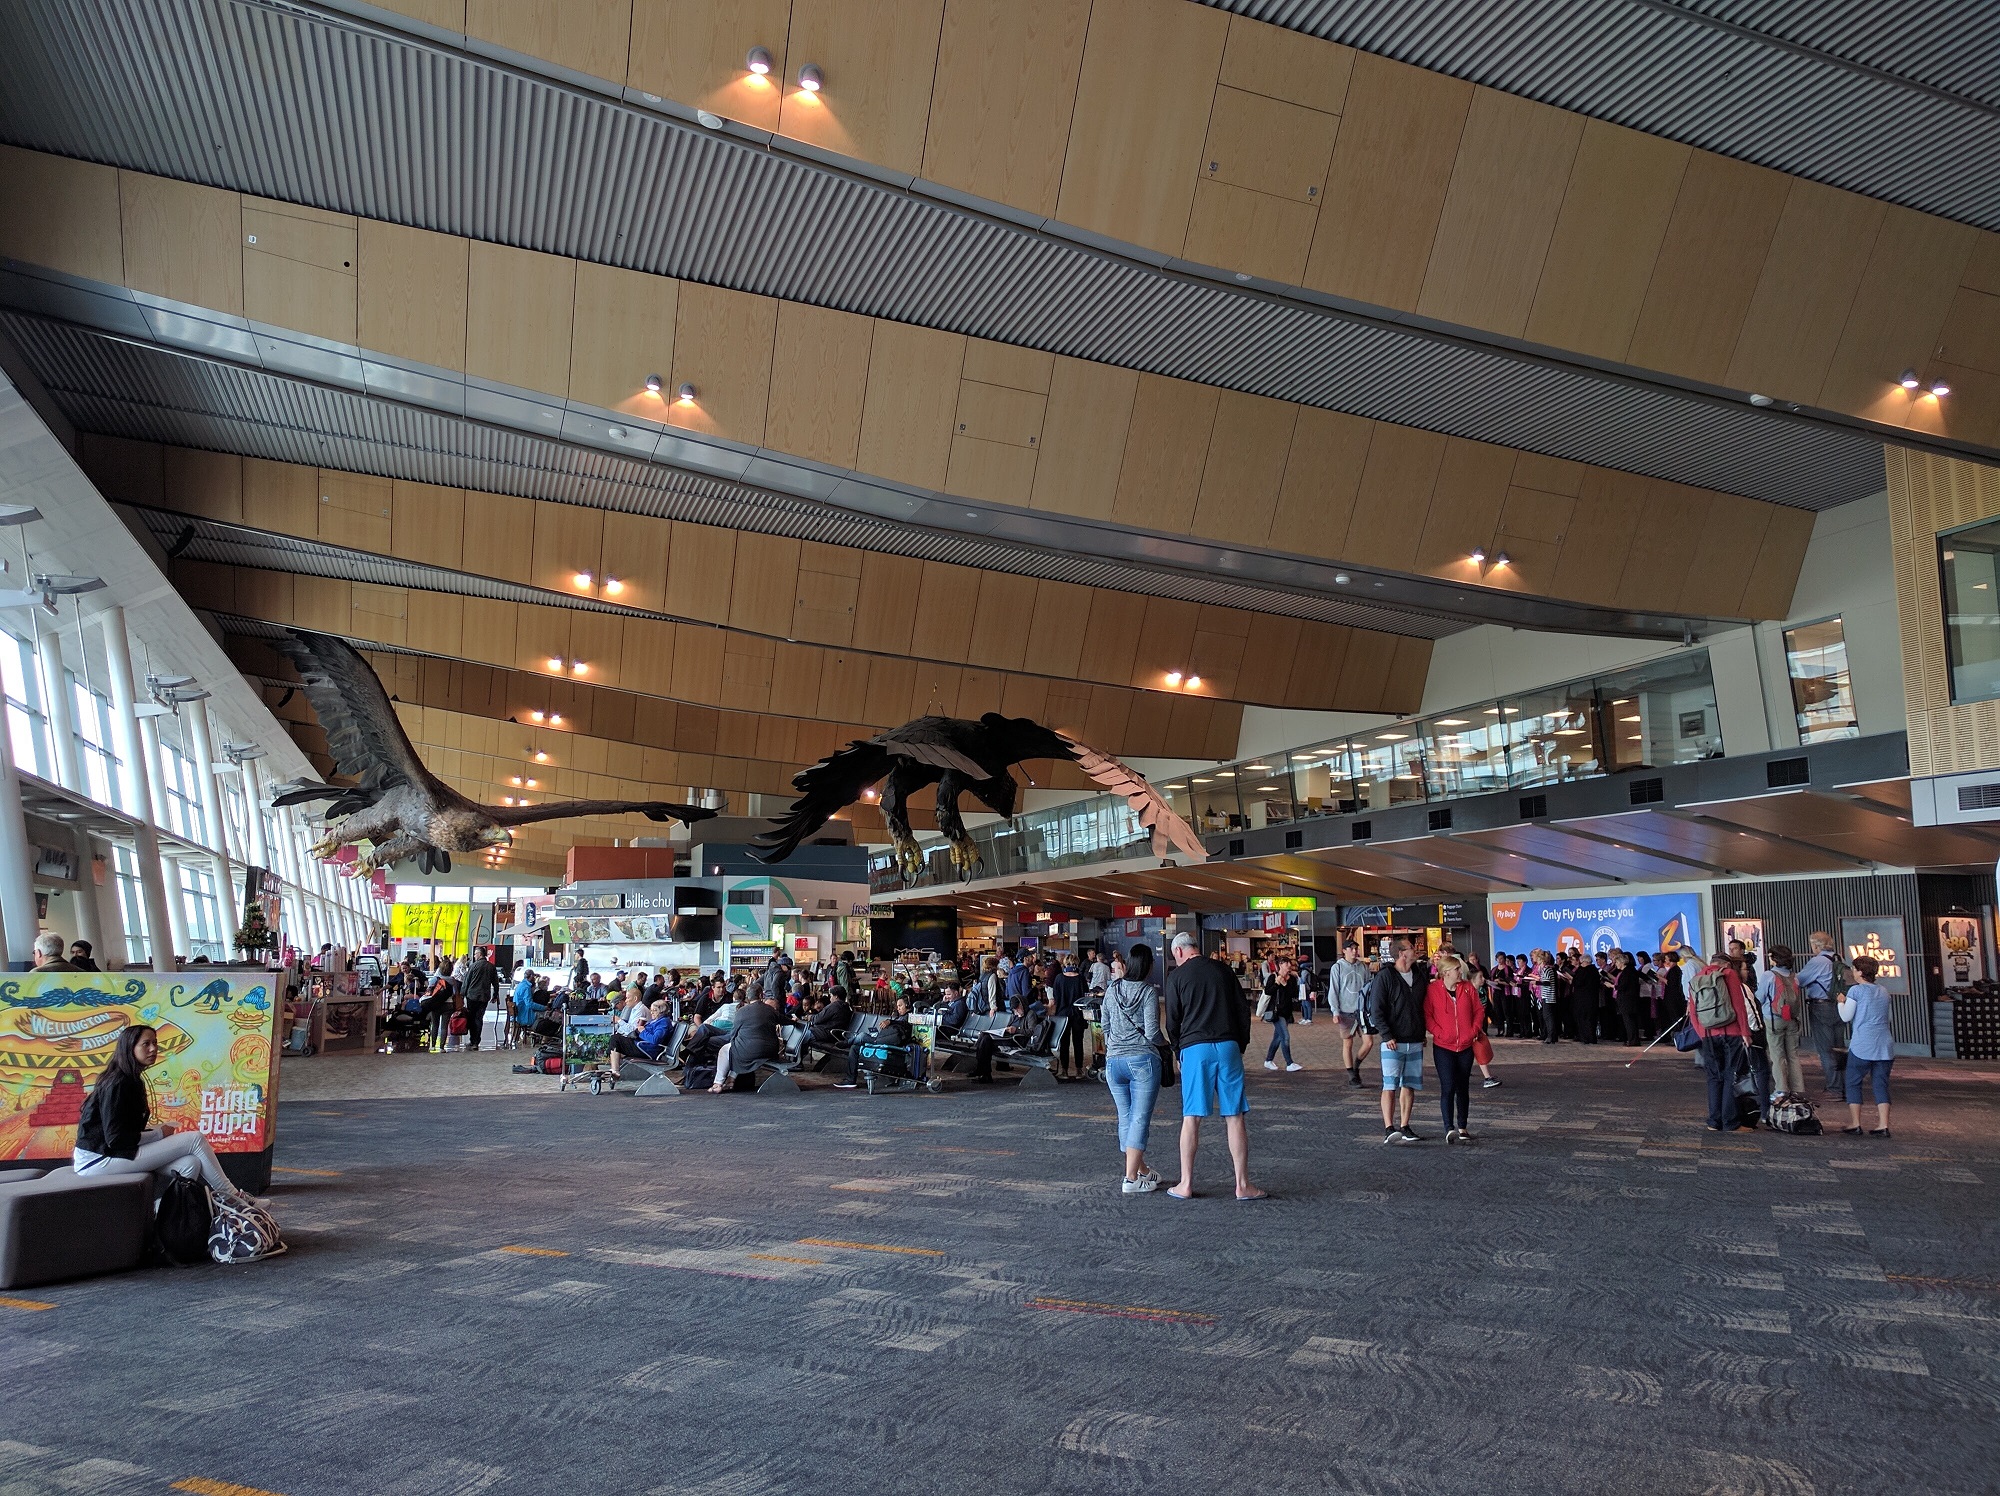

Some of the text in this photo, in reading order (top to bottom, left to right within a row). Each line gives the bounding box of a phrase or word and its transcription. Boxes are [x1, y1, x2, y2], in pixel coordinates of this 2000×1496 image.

[625, 892, 671, 909] billie chu
[1256, 898, 1291, 908] SUBWAY
[1036, 912, 1051, 921] RELAY
[1135, 906, 1152, 916] RELAY
[1496, 909, 1516, 919] Fly Buys
[1542, 907, 1634, 922] Only Fly Buys gets you
[1867, 932, 1880, 948] 3
[1849, 945, 1896, 961] Wise
[31, 1012, 111, 1035] WELLINGTON
